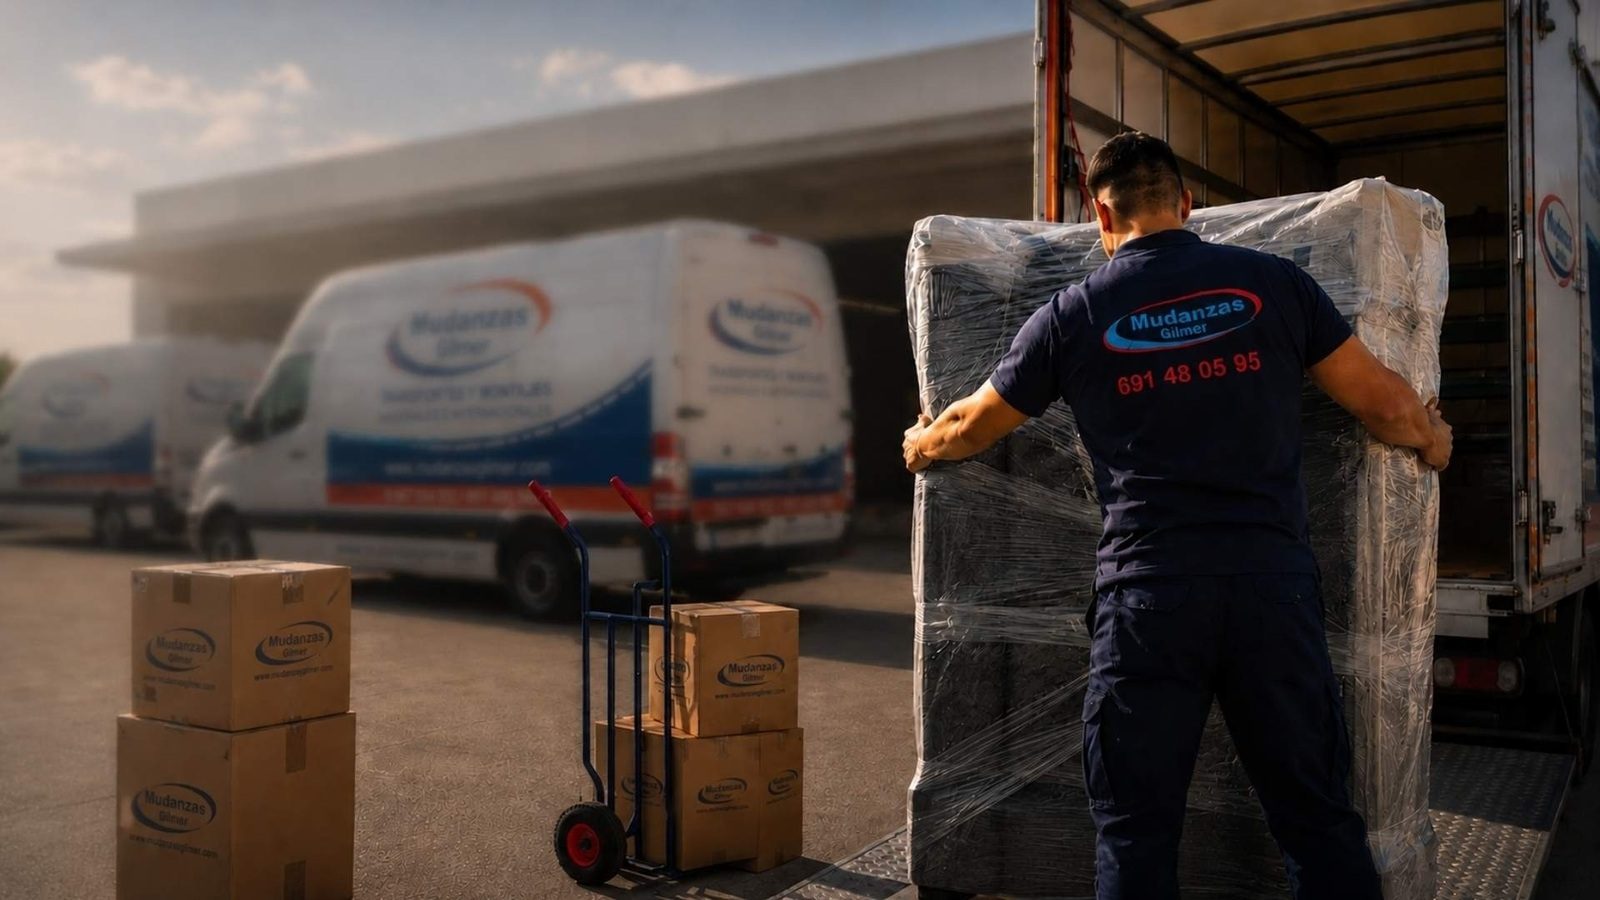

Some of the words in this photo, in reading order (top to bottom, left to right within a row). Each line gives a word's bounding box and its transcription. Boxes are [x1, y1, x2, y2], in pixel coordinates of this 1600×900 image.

[410, 307, 528, 336] Mudanzas
[728, 299, 812, 327] Mudanzas
[1130, 299, 1245, 331] Mudanzas
[1160, 323, 1208, 339] Gilmer
[1117, 370, 1155, 396] 691
[1163, 364, 1192, 385] 48
[1198, 357, 1227, 379] 05
[1233, 351, 1262, 373] 95
[156, 635, 208, 654] Mudanzas
[268, 631, 325, 648] Mudanzas
[167, 652, 193, 665] Gilmer
[282, 647, 308, 658] Gilmer
[728, 662, 777, 674] Mudanzas
[144, 788, 206, 816] Mudanzas
[159, 810, 188, 826] Gilmer
